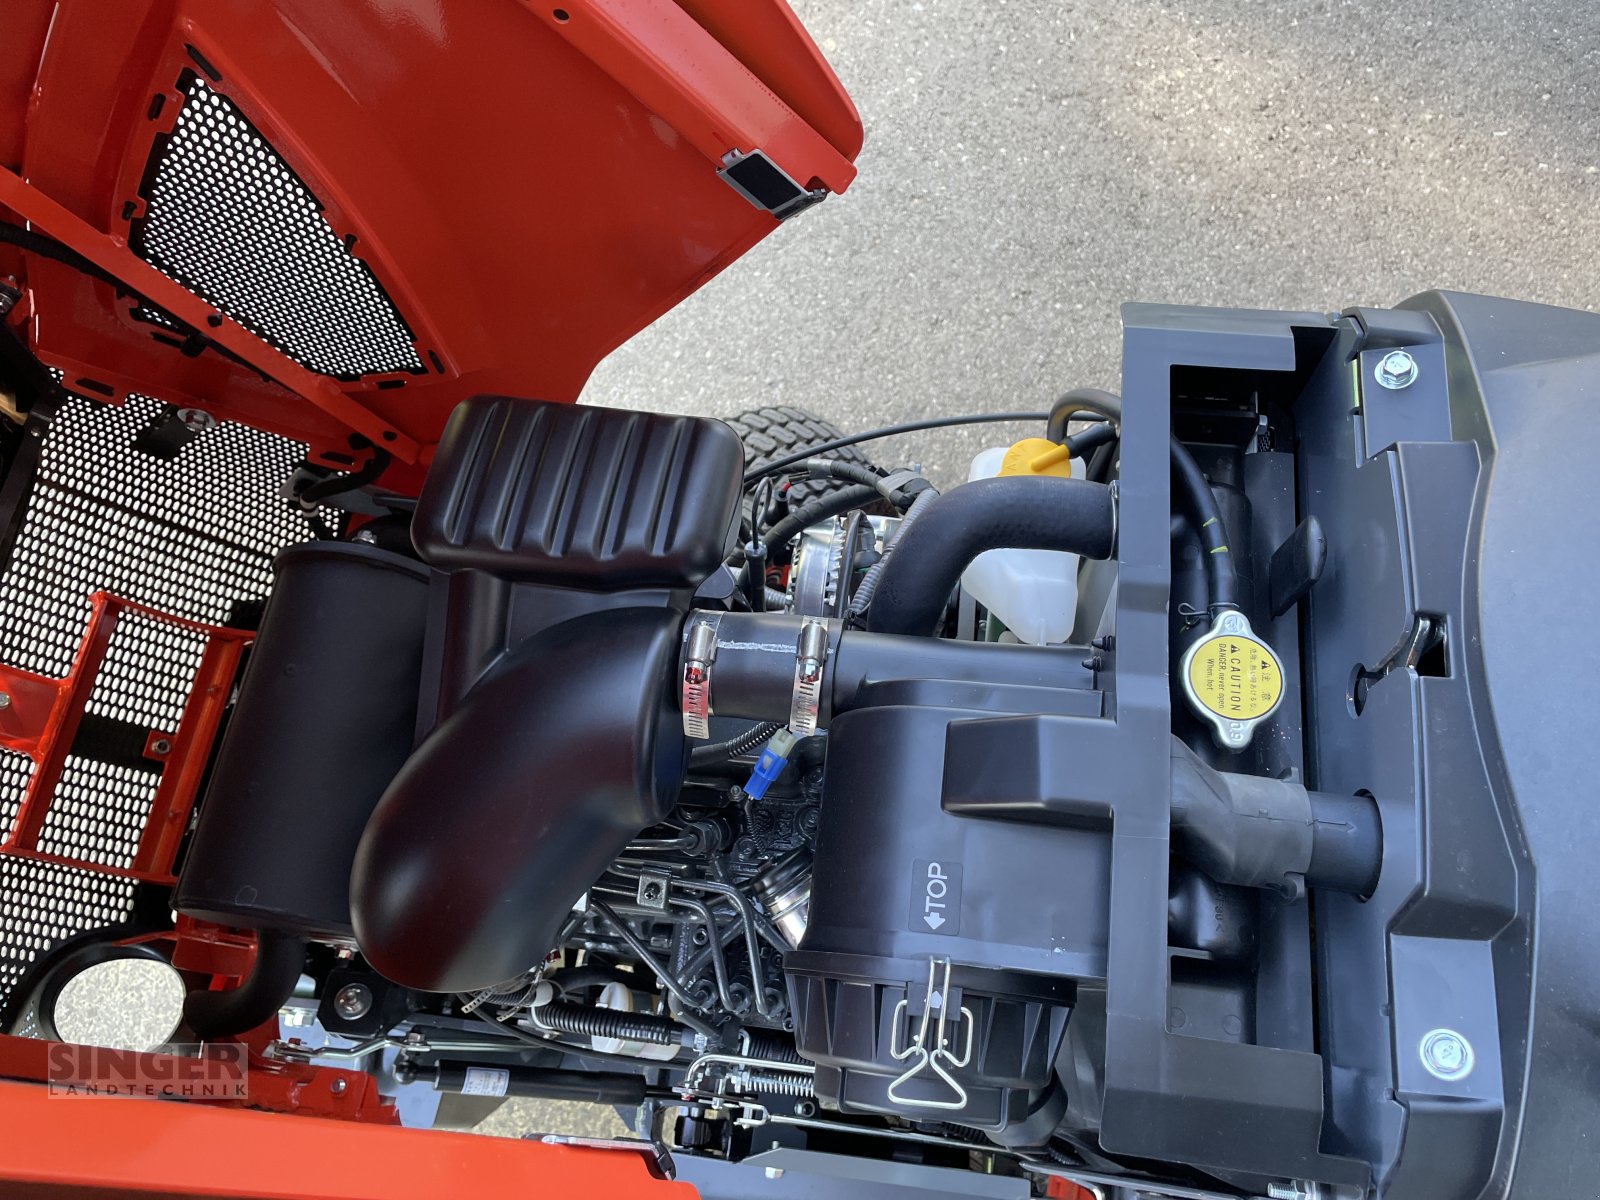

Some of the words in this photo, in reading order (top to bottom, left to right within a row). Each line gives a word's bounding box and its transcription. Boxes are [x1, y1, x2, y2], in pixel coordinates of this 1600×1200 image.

[1217, 692, 1225, 709] open
[1230, 658, 1241, 711] CAUTION
[925, 862, 948, 913] TOP
